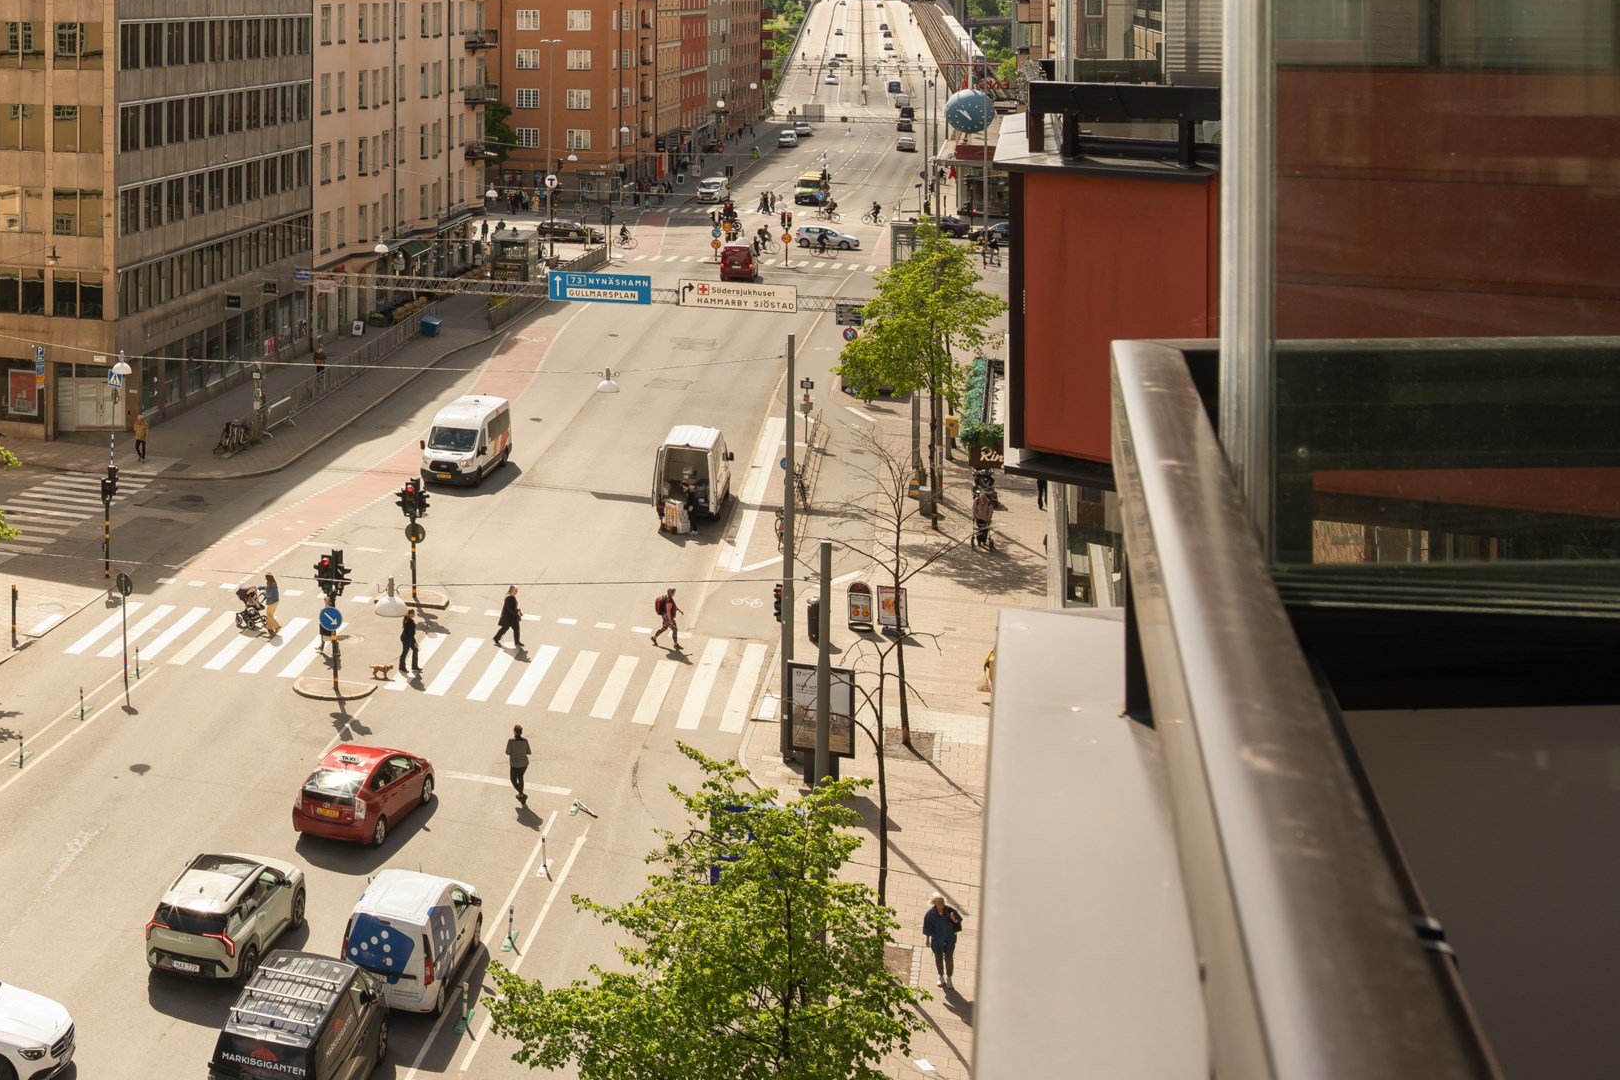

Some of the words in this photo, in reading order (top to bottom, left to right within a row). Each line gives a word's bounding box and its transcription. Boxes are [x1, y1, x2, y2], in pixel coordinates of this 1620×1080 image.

[588, 277, 649, 287] NYNÄSHAMN
[568, 289, 636, 300] GULLMARSPLAN
[711, 286, 776, 297] Södersjukhuset
[696, 297, 749, 307] HAMMARBY
[753, 299, 795, 310] SJÖSTAD
[980, 446, 1004, 467] Rin
[221, 1051, 306, 1077] MARKISGIGANTEN
